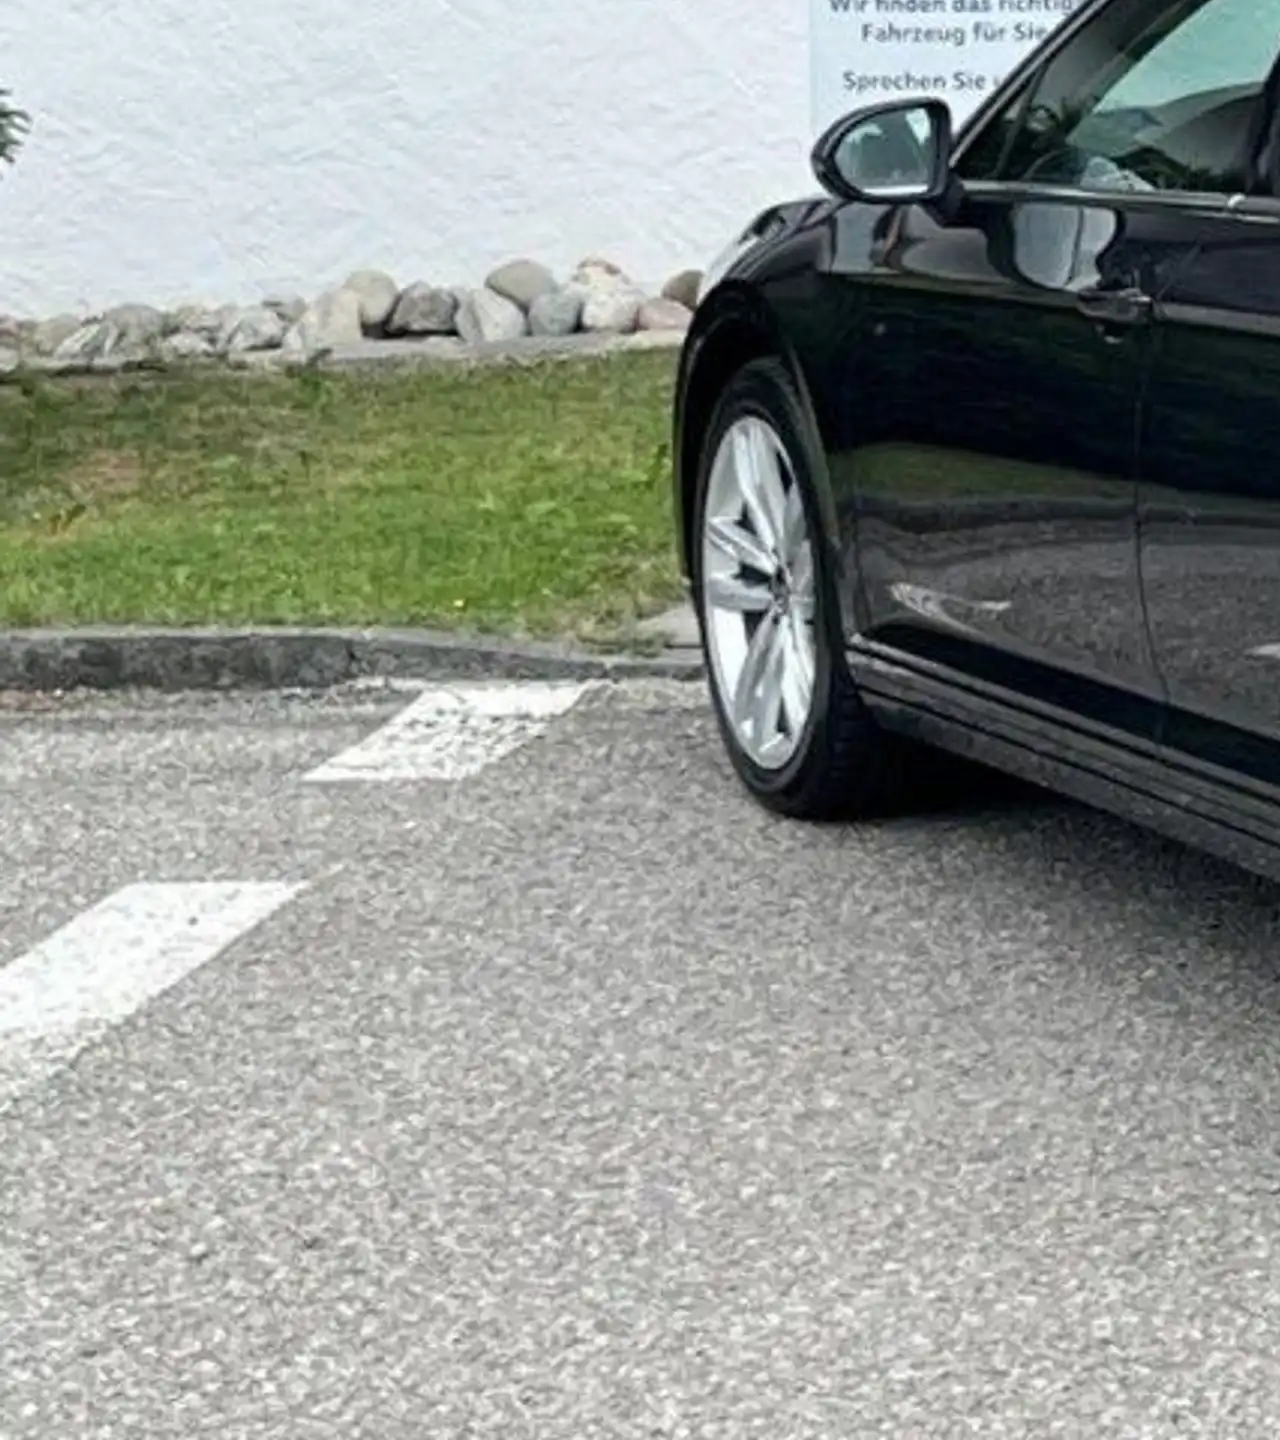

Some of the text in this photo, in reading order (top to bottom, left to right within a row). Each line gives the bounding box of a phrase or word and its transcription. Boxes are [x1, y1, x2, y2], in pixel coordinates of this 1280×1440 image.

[861, 21, 966, 48] Fahrzeug
[972, 21, 1006, 44] für
[842, 70, 947, 94] Sprechen
[952, 71, 987, 91] Sie
